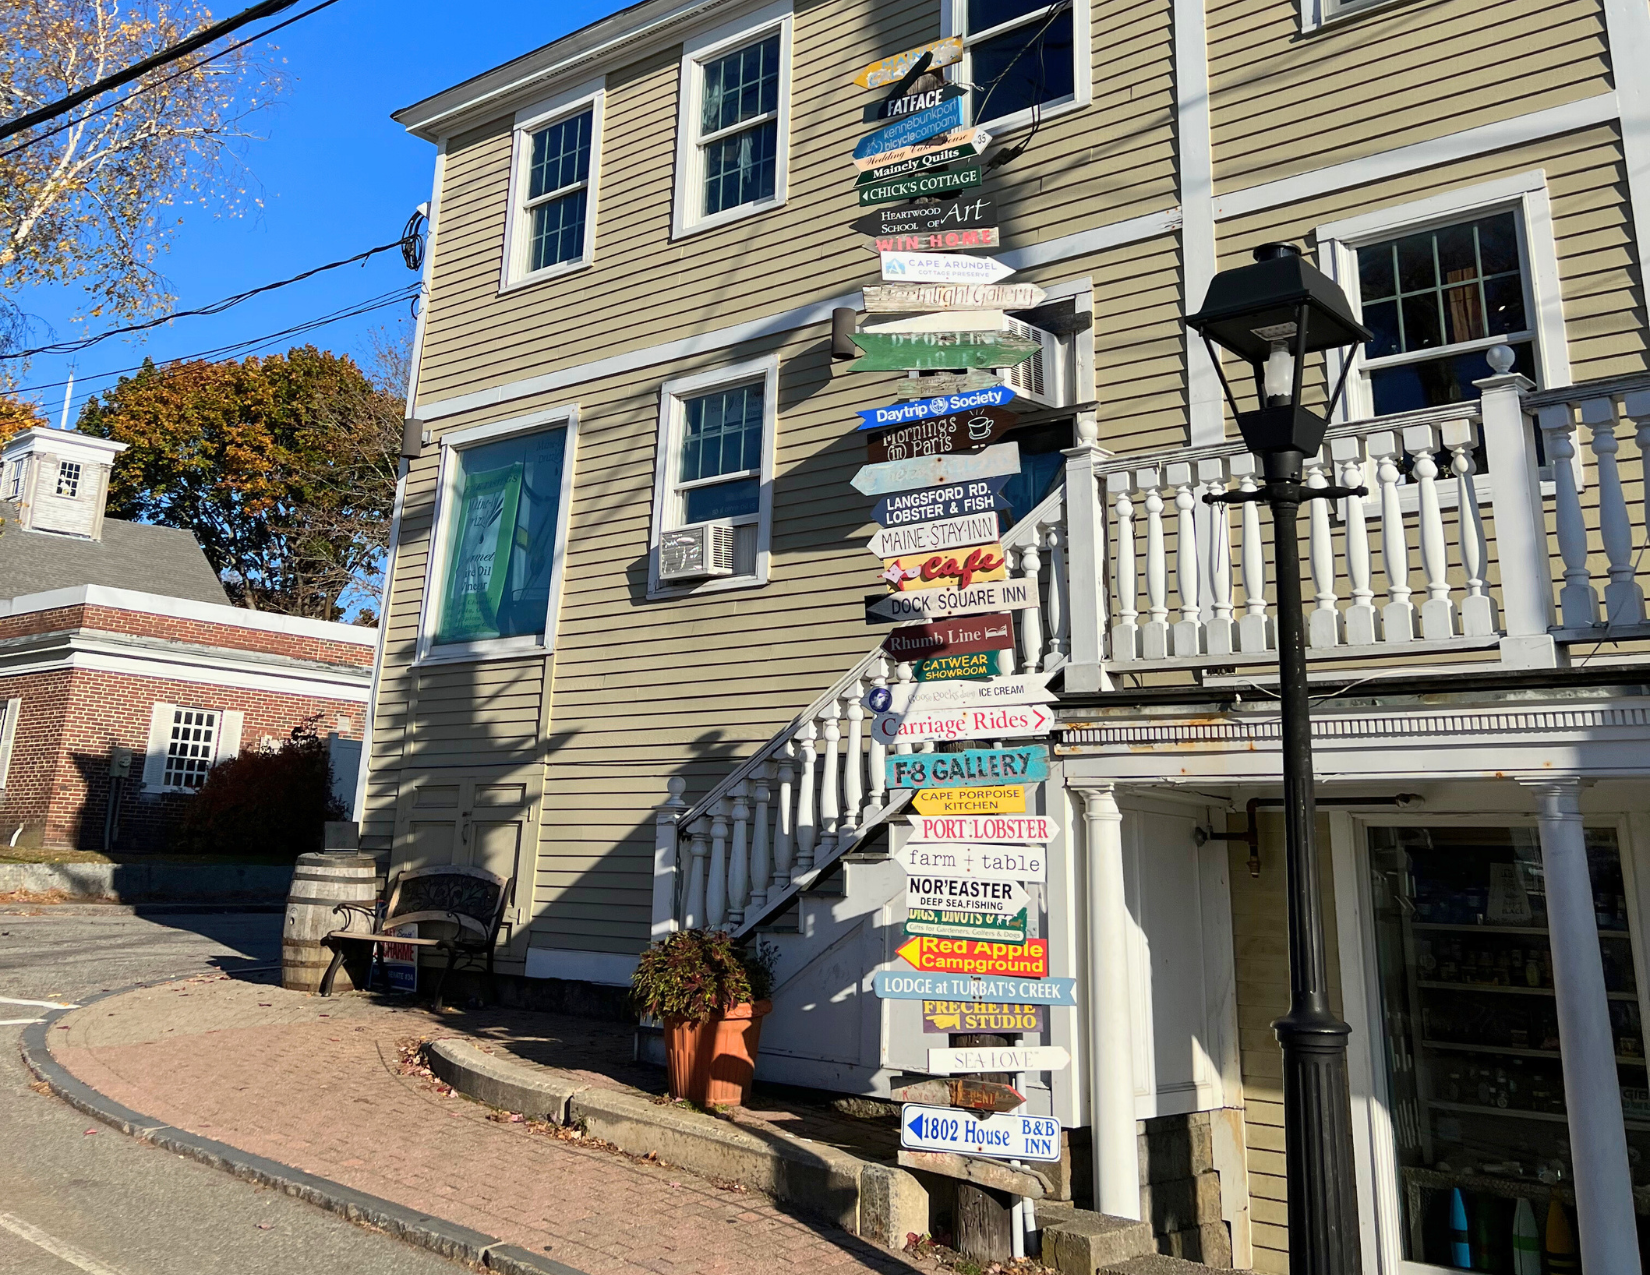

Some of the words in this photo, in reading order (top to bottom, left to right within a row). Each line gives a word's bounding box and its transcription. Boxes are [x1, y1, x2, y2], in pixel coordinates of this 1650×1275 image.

[887, 89, 944, 117] FATFACE
[884, 98, 958, 139] kennebunkport
[866, 150, 906, 166] Wedding
[977, 133, 986, 145] 35
[873, 159, 919, 180] Mainely
[922, 148, 960, 167] Quilts
[870, 180, 917, 200] CHICK'S
[919, 170, 977, 191] COTTAGE
[941, 198, 991, 224] Art
[930, 230, 992, 248] HOME
[908, 259, 940, 267] CAPE
[944, 260, 998, 270] ARUNDEL
[952, 270, 990, 278] PRESERVE
[876, 404, 928, 423] Daytrip
[949, 391, 1003, 409] Society
[883, 416, 957, 447] Mornings
[912, 435, 953, 458] Paris
[886, 487, 964, 511] LANGSFORD
[968, 482, 991, 495] RD.
[886, 503, 944, 525] LOBSTER
[949, 502, 958, 513] &
[964, 495, 994, 512] FISH
[881, 527, 926, 553] MAINE
[930, 522, 965, 546] STAY
[966, 517, 993, 541] INN
[891, 595, 931, 615] DOCK
[938, 589, 995, 610] SQUARE
[1002, 585, 1027, 604] INN
[890, 631, 943, 651] Rhumb
[947, 628, 982, 644] Line
[922, 654, 988, 672] CATWEAR
[925, 665, 987, 681] SHOWROOM
[978, 686, 992, 697] ICE
[993, 684, 1025, 696] CREAM
[881, 715, 966, 739] Carriage
[972, 710, 1028, 732] Rides
[931, 751, 1033, 783] GALLERY
[920, 792, 954, 801] CAPE
[959, 788, 1020, 800] PORPOISE
[944, 801, 998, 811] KITCHEN
[922, 818, 968, 839] PORT
[972, 818, 1049, 839] LOBSTER
[909, 849, 957, 867] farm
[981, 854, 1040, 872] table
[909, 877, 1012, 900] NOR'EASTER
[920, 897, 943, 907] DEEP
[966, 900, 1003, 911] FISHING
[909, 924, 924, 932] Gifts
[925, 924, 935, 932] for
[971, 928, 996, 937] Golfers
[997, 929, 1002, 937] &
[1003, 930, 1021, 940] Dogs
[922, 938, 970, 954] Red
[973, 940, 1044, 960] Apple
[921, 954, 1044, 974] Campground
[884, 977, 932, 994] LODGE
[935, 981, 948, 994] at
[950, 979, 1016, 998] TURBAT'S
[1019, 982, 1061, 999] CREEK
[965, 1014, 1037, 1030] STUDIO
[954, 1052, 986, 1069] SEA
[923, 1117, 959, 1141] 1802
[964, 1120, 1010, 1147] House
[1022, 1119, 1055, 1137] B&B
[1024, 1138, 1052, 1155] INN
